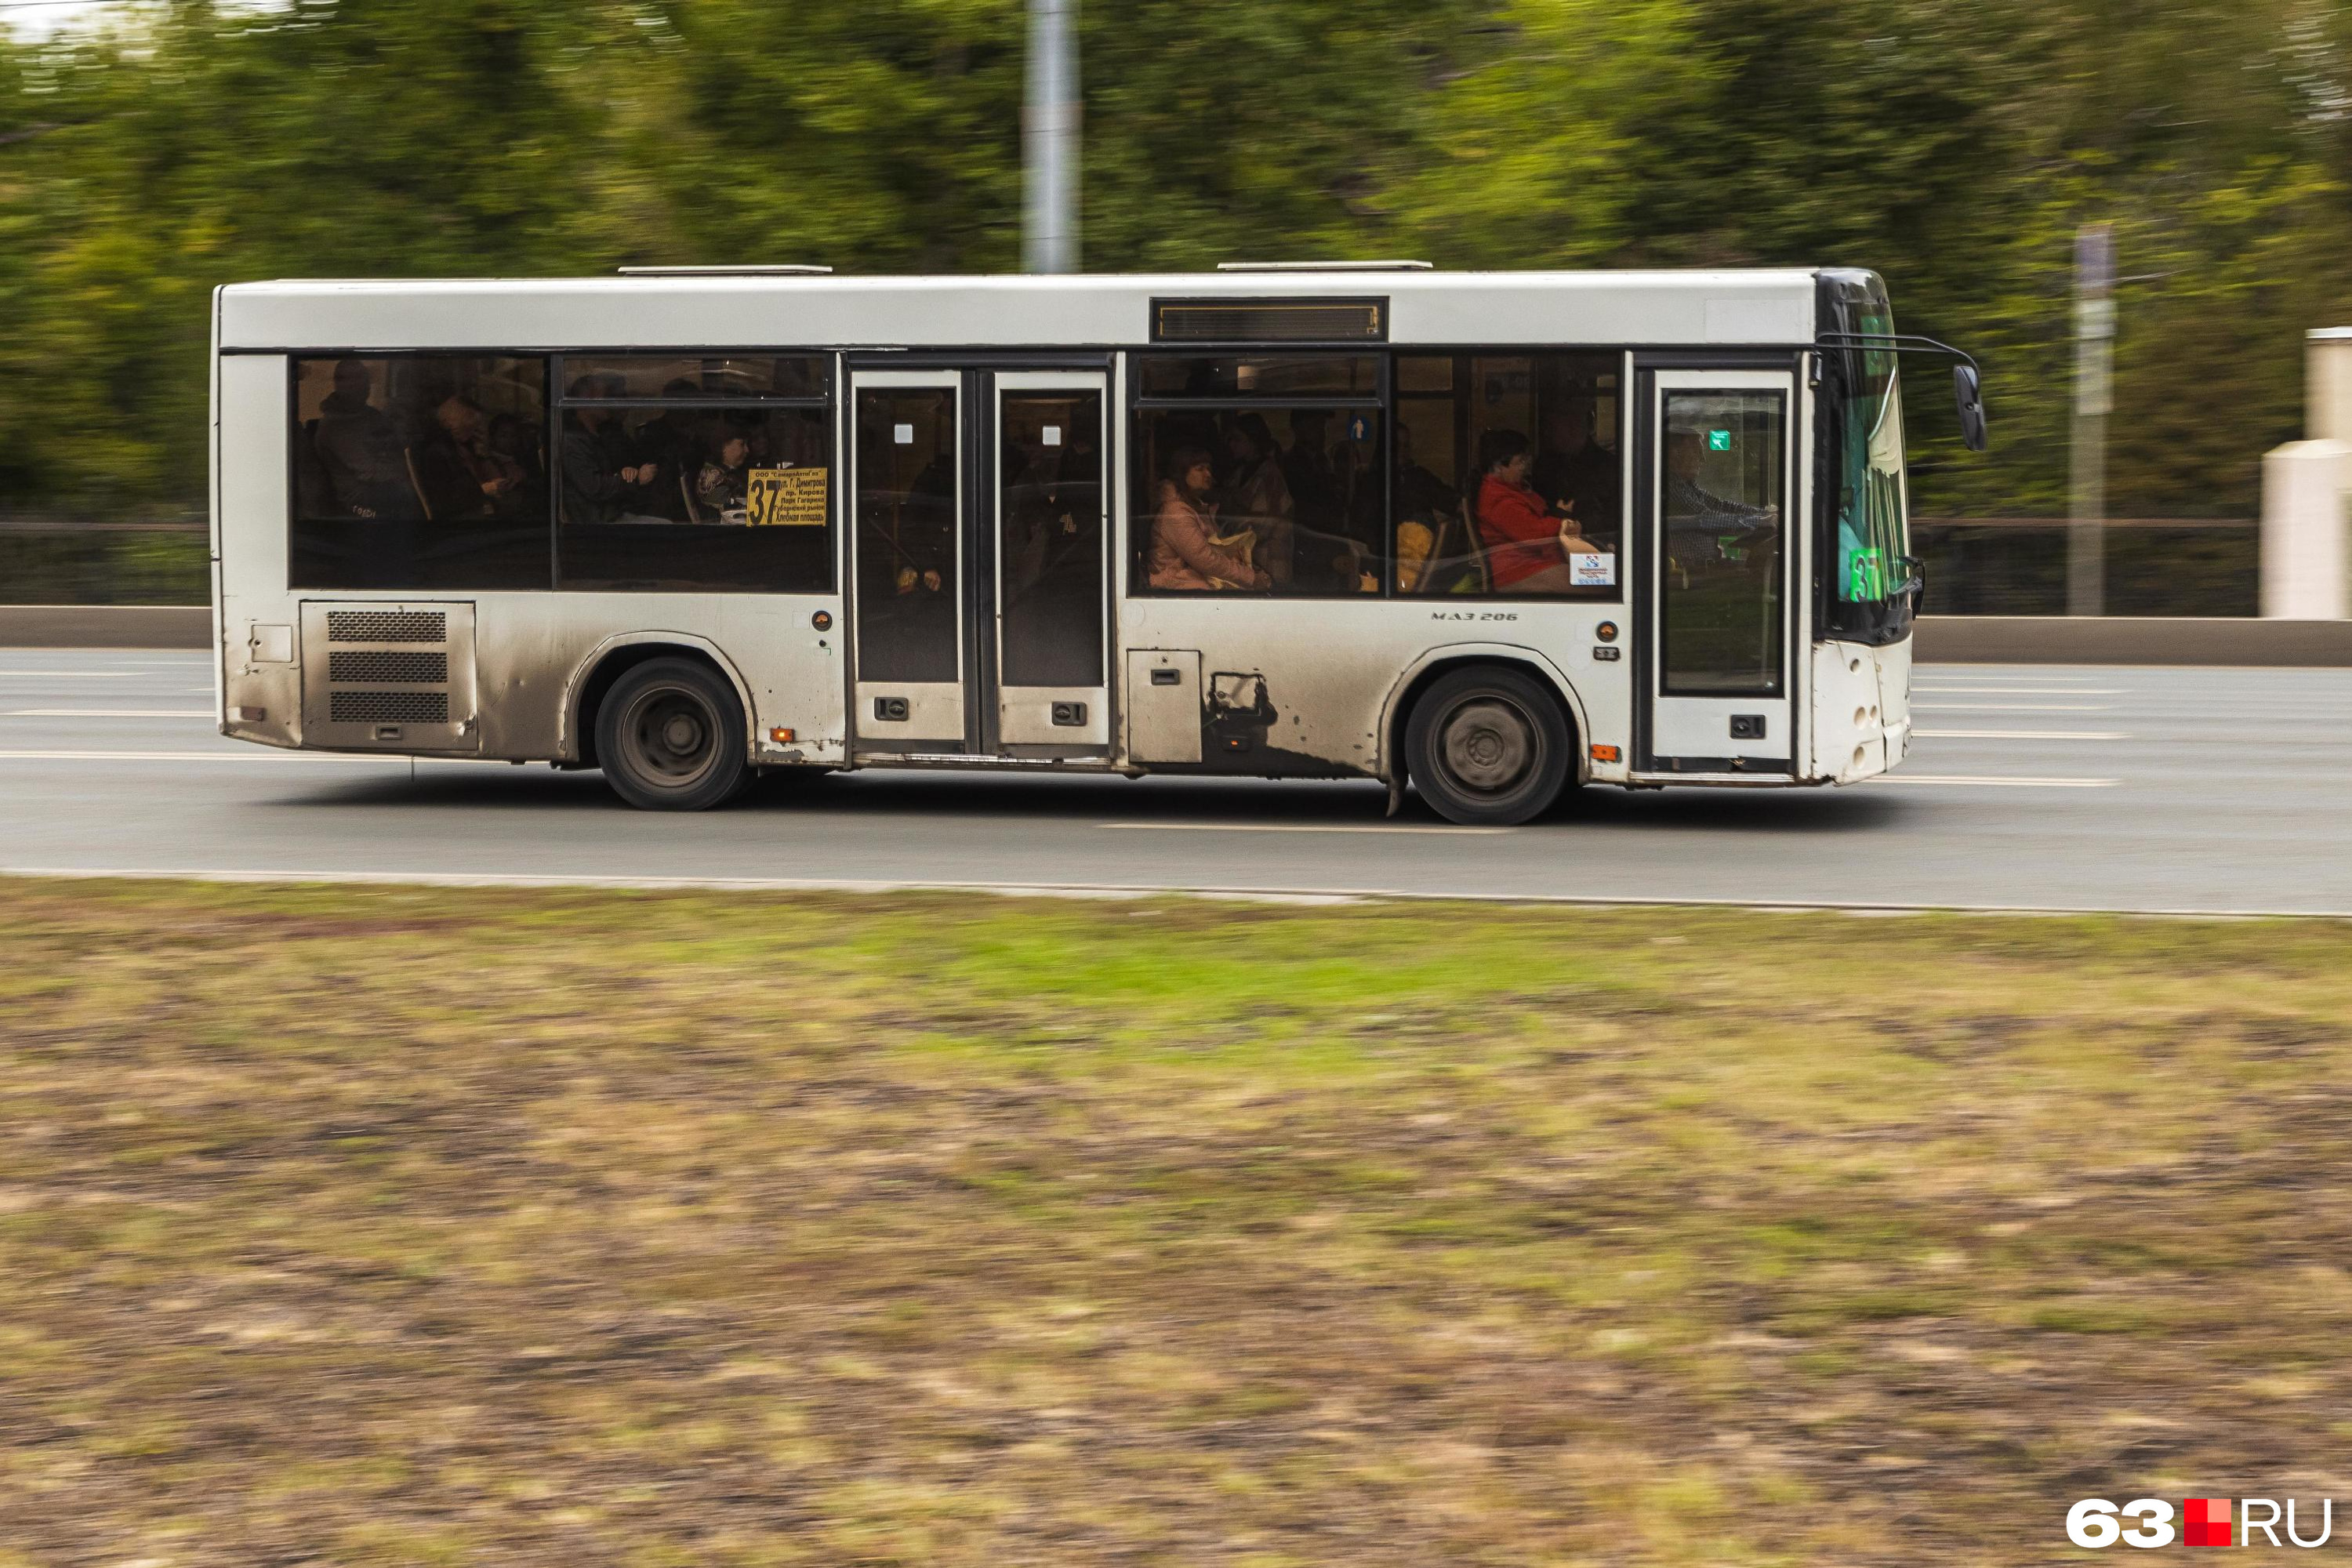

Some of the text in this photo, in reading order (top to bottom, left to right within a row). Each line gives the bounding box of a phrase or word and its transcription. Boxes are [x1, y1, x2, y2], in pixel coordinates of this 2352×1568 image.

[796, 477, 826, 490] Димитрова
[750, 479, 782, 524] 37
[776, 511, 824, 523] Хлебная площадь
[1855, 557, 1880, 602] 37
[1431, 612, 1519, 621] МАЗ 206
